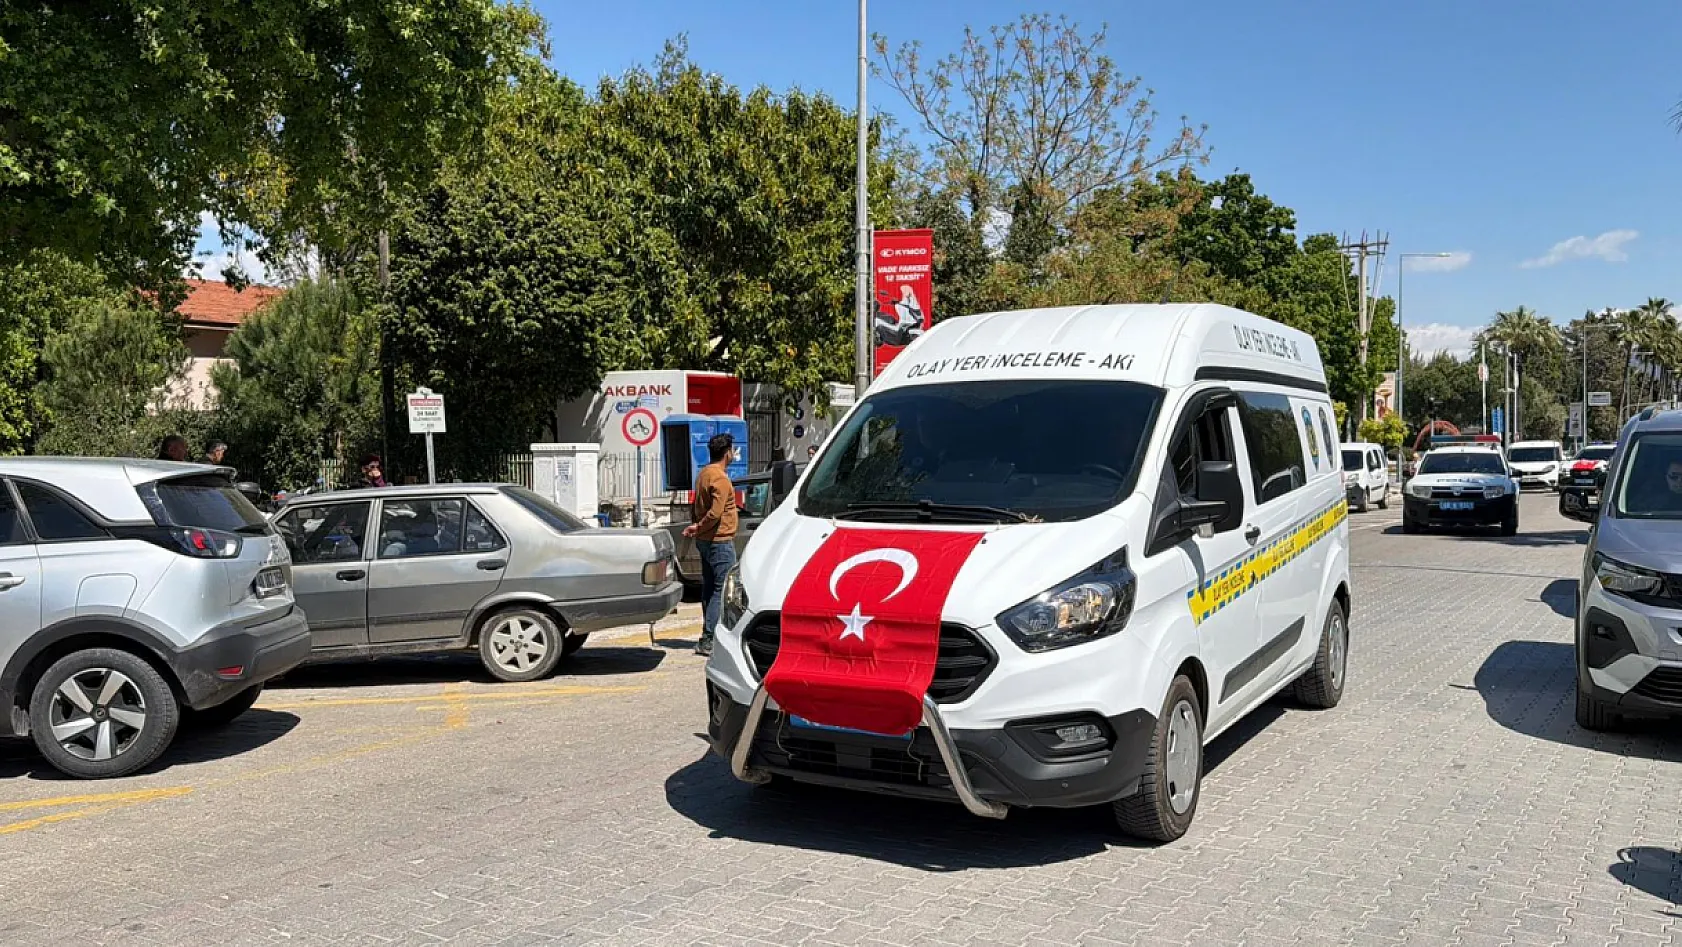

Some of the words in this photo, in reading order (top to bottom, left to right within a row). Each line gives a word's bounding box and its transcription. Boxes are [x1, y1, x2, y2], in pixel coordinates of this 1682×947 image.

[895, 248, 927, 256] KYMCO
[878, 265, 897, 273] VADE
[906, 358, 951, 378] OLAY
[604, 384, 672, 397] AKBANK
